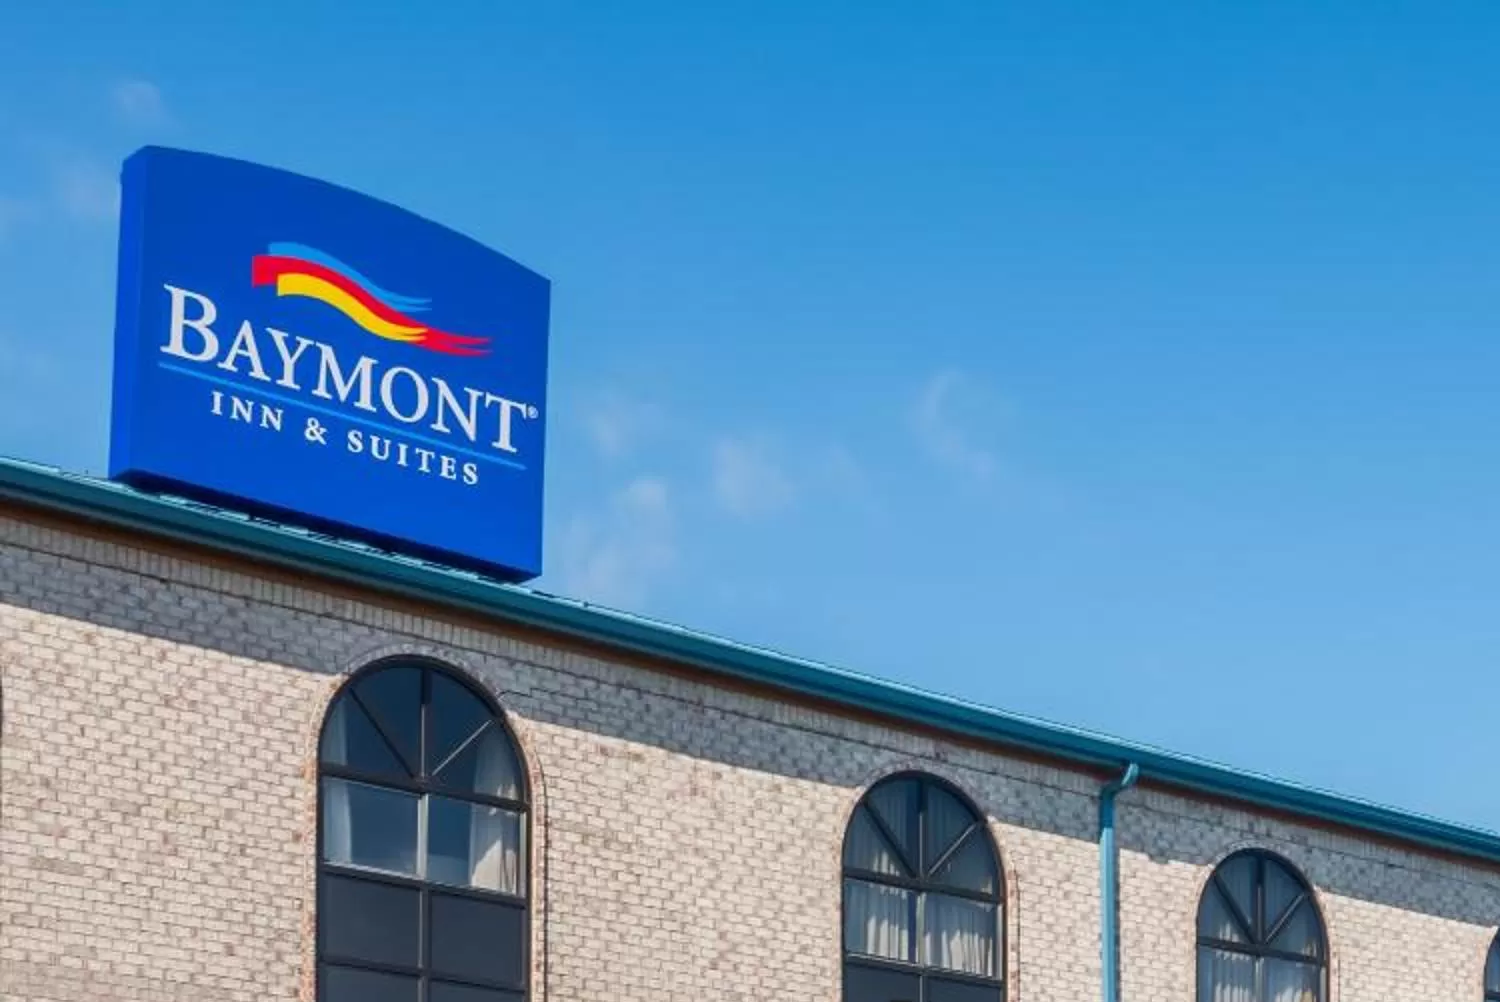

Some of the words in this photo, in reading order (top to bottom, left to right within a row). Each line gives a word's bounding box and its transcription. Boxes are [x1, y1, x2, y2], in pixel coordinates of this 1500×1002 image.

[211, 391, 284, 431] INN
[304, 416, 328, 445] &
[346, 429, 479, 486] SUITES
